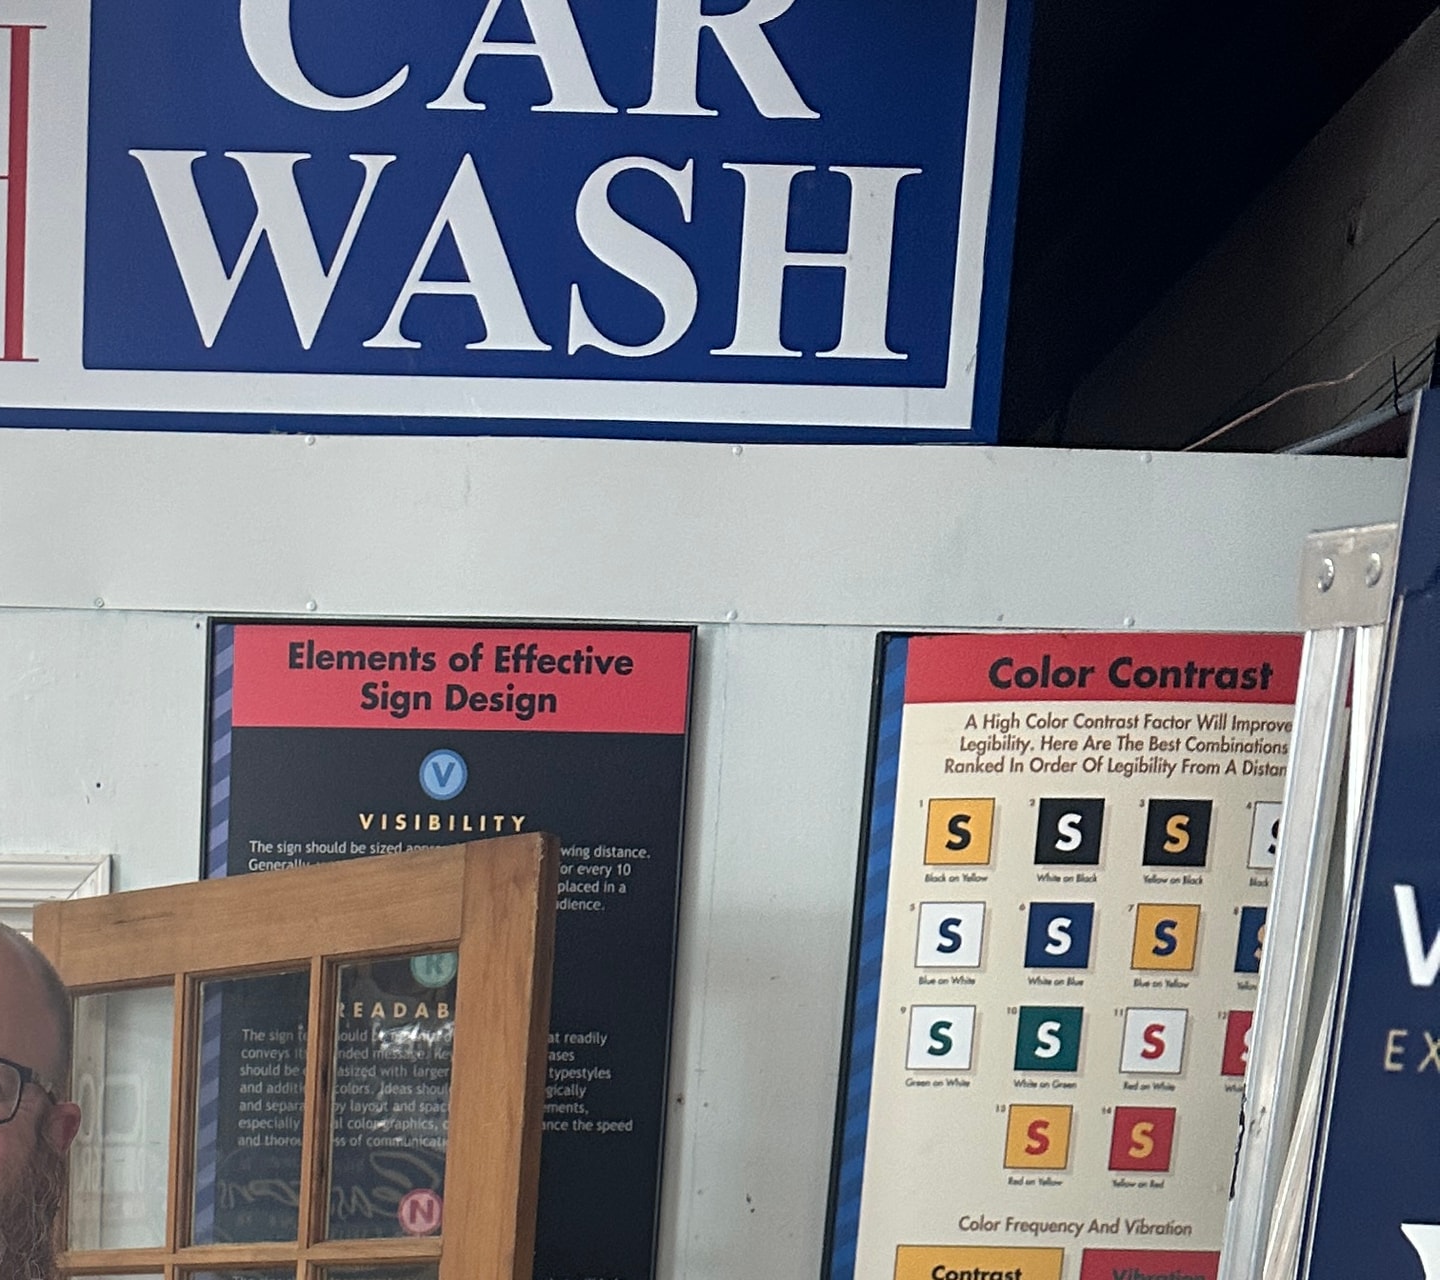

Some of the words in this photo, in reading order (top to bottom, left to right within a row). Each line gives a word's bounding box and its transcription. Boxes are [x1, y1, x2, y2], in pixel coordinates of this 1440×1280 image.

[127, 148, 923, 361] WASH
[288, 640, 437, 671] Elements
[448, 642, 484, 673] of
[494, 644, 634, 676] Effective
[989, 655, 1095, 689] Color
[1108, 656, 1273, 690] Contrast
[360, 682, 432, 719] Sign
[445, 684, 558, 721] Design
[964, 714, 978, 729] A
[983, 712, 1020, 733] High
[1026, 713, 1068, 729] Color
[1073, 713, 1139, 730] Contrast
[1143, 713, 1192, 730] Factor
[1196, 713, 1227, 730] Will
[959, 736, 1035, 756] Legibility.
[1041, 736, 1078, 751] Here
[1083, 737, 1111, 751] Are
[1116, 735, 1145, 751] The
[1149, 736, 1180, 752] Best
[1185, 737, 1289, 755] Combinations
[432, 762, 457, 788] V
[944, 756, 1004, 774] Ranked
[1010, 757, 1024, 773] In
[1029, 757, 1078, 774] Order
[1082, 756, 1104, 774] Of
[1107, 757, 1177, 778] Legibility
[1181, 759, 1220, 775] From
[1225, 760, 1237, 775] A
[359, 813, 528, 832] VISIBILITY
[945, 814, 972, 851] S
[1055, 814, 1082, 851] S
[1162, 814, 1190, 853] S
[249, 840, 273, 853] The
[276, 841, 302, 856] sign
[305, 841, 346, 854] should
[350, 841, 367, 854] be
[369, 843, 402, 855] sized
[594, 845, 650, 859] distance.
[577, 865, 612, 878] every
[617, 864, 631, 875] 10
[558, 881, 599, 894] placed
[604, 882, 615, 893] in
[936, 918, 962, 953] S
[1045, 918, 1072, 955] S
[1152, 920, 1178, 956] S
[242, 1029, 265, 1041] The
[269, 1029, 291, 1044] sign
[564, 1033, 607, 1048] readily
[927, 1021, 953, 1056] S
[1034, 1021, 1062, 1058] S
[1140, 1023, 1167, 1060] S
[241, 1050, 291, 1062] conveys
[240, 1065, 280, 1077] should
[284, 1065, 300, 1077] be
[381, 1065, 408, 1077] with
[549, 1067, 612, 1082] typestyles
[240, 1082, 263, 1094] and
[239, 1099, 262, 1110] and
[392, 1100, 416, 1111] and
[238, 1119, 300, 1131] especially
[572, 1119, 594, 1131] the
[596, 1120, 633, 1133] speed
[1024, 1119, 1050, 1155] S
[238, 1135, 260, 1146] and
[1128, 1121, 1154, 1158] S
[409, 1200, 434, 1224] N
[958, 1214, 1000, 1231] Color
[1005, 1217, 1085, 1236] Frequency
[1087, 1217, 1120, 1234] And
[1124, 1218, 1193, 1236] Vibration
